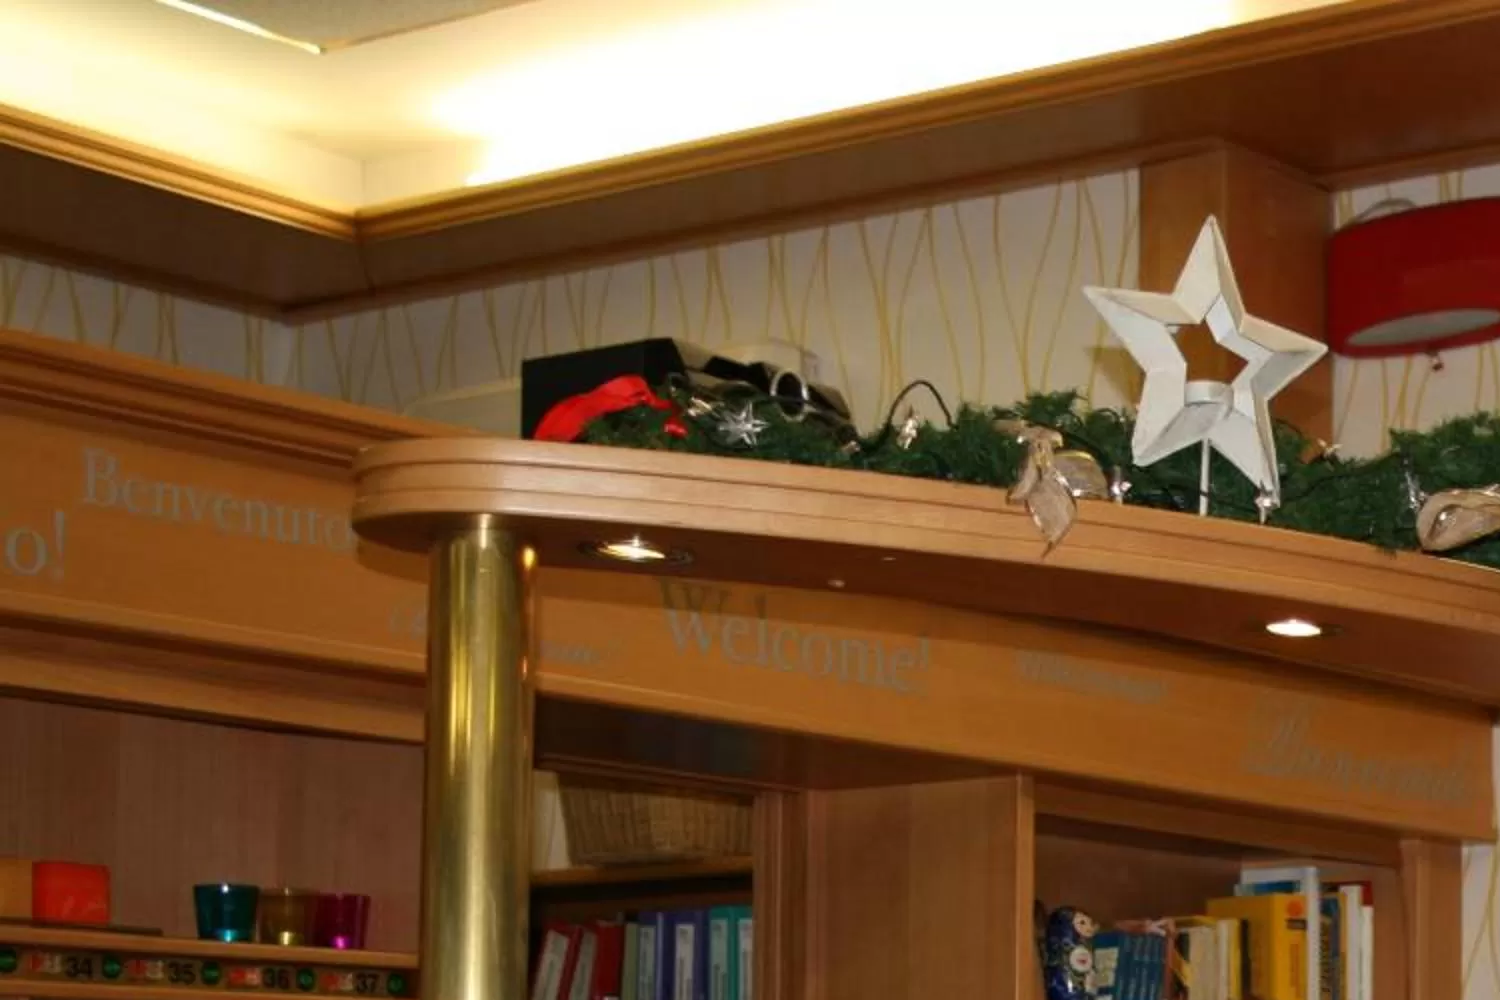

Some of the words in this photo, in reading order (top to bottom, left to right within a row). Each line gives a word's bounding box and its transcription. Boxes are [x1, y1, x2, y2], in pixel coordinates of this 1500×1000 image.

[655, 574, 932, 697] Welcome!
[65, 955, 93, 980] 34
[167, 960, 197, 985] 35
